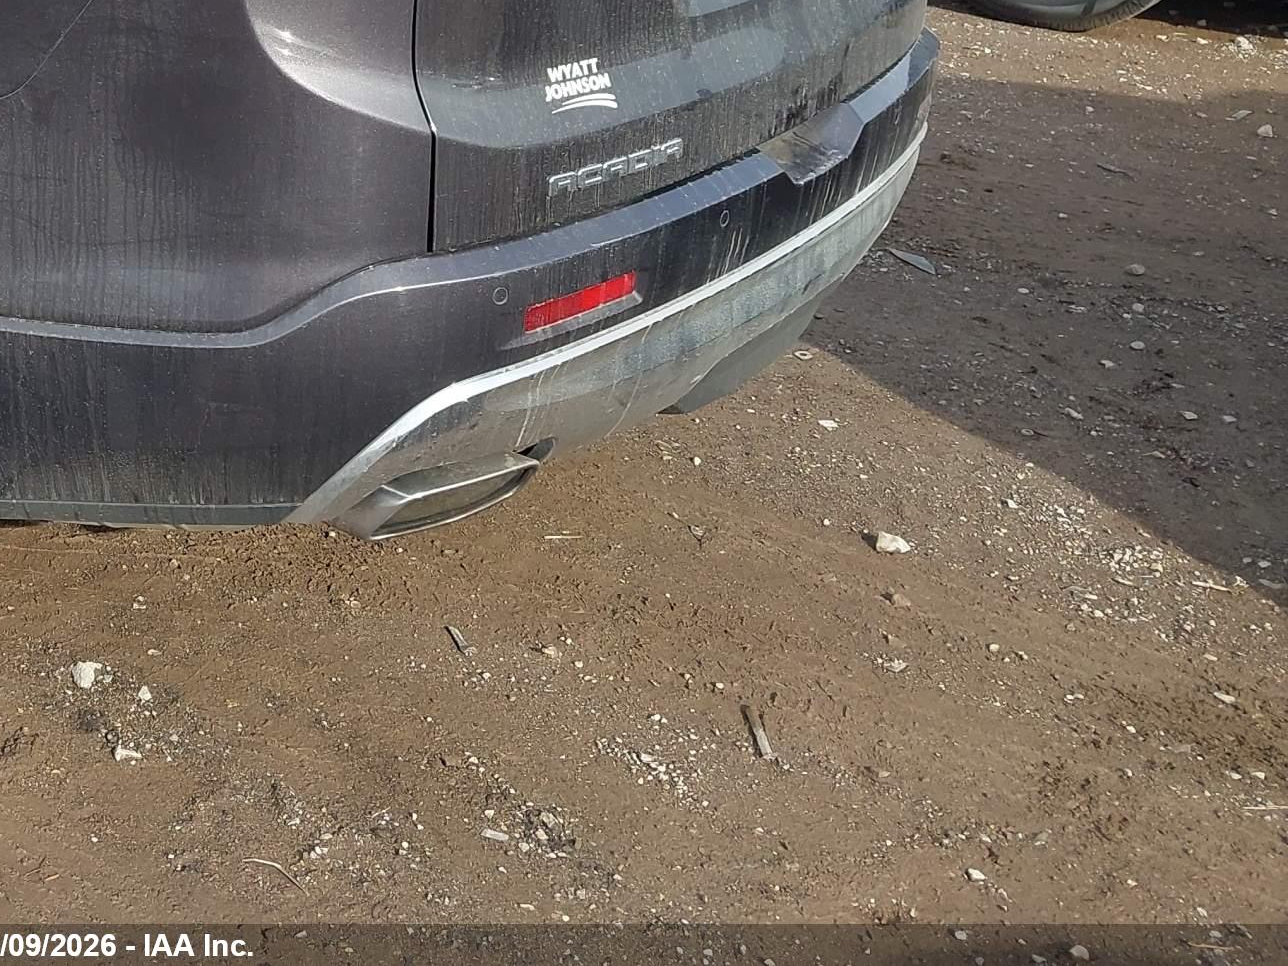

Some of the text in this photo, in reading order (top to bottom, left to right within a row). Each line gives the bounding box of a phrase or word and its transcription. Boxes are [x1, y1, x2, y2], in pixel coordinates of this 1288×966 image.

[547, 58, 598, 83] WYATT
[545, 73, 612, 102] JOHNSON
[548, 138, 684, 197] ACADIA
